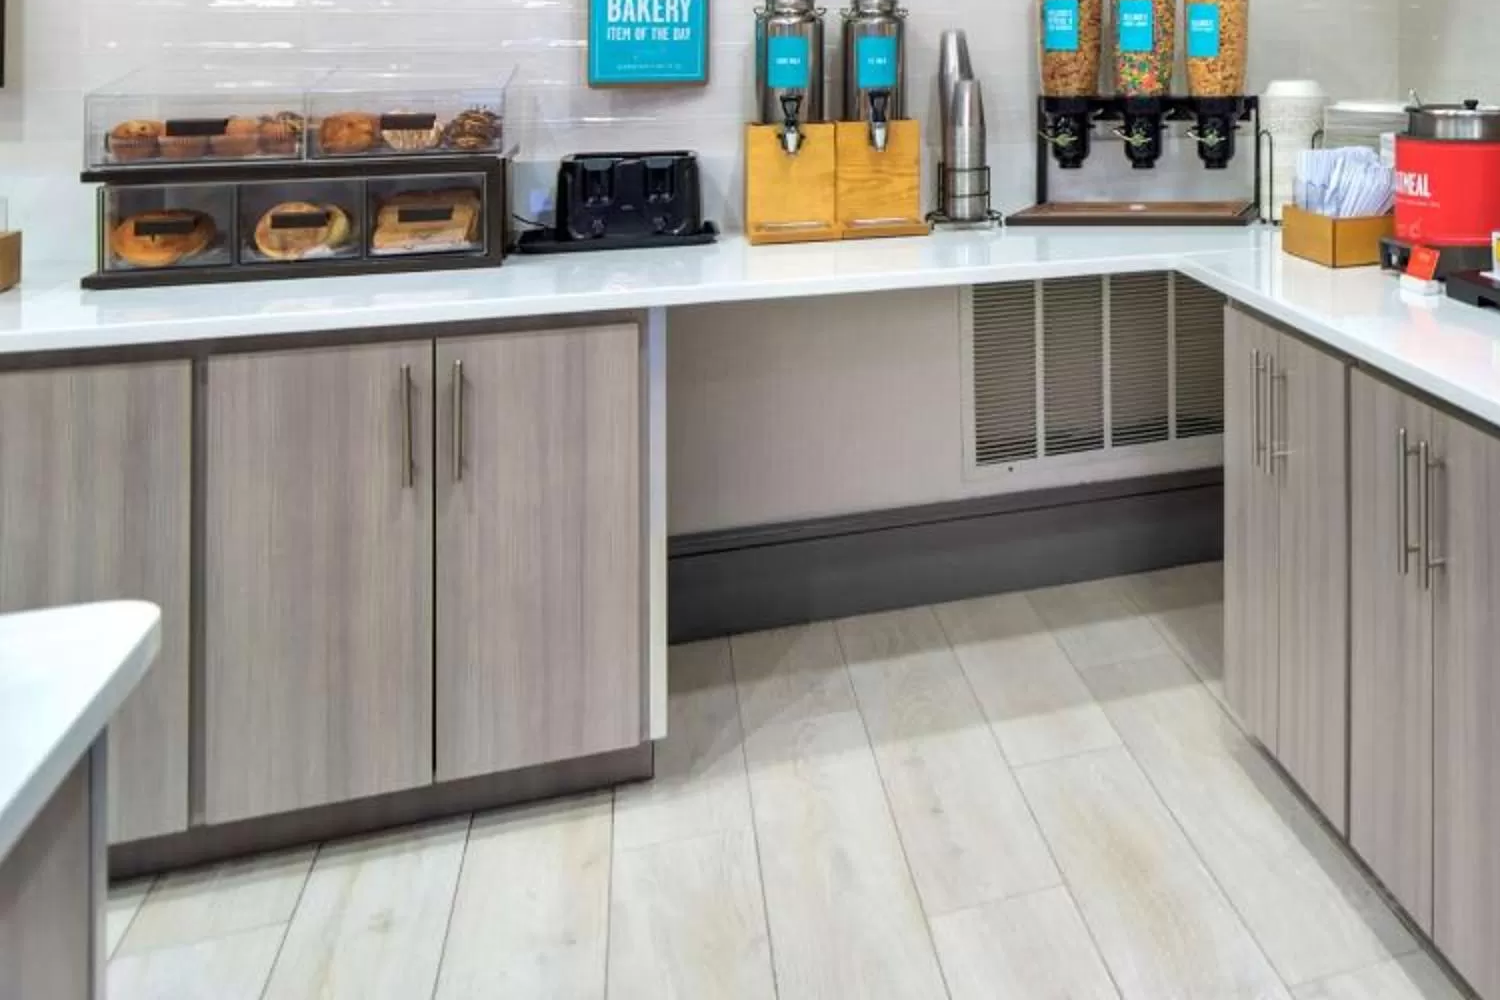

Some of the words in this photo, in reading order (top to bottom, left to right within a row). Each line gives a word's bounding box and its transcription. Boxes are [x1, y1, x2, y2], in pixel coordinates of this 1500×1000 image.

[607, 27, 631, 40] ITEM
[634, 27, 646, 40] OF
[651, 27, 669, 40] THE
[673, 27, 691, 40] DAY
